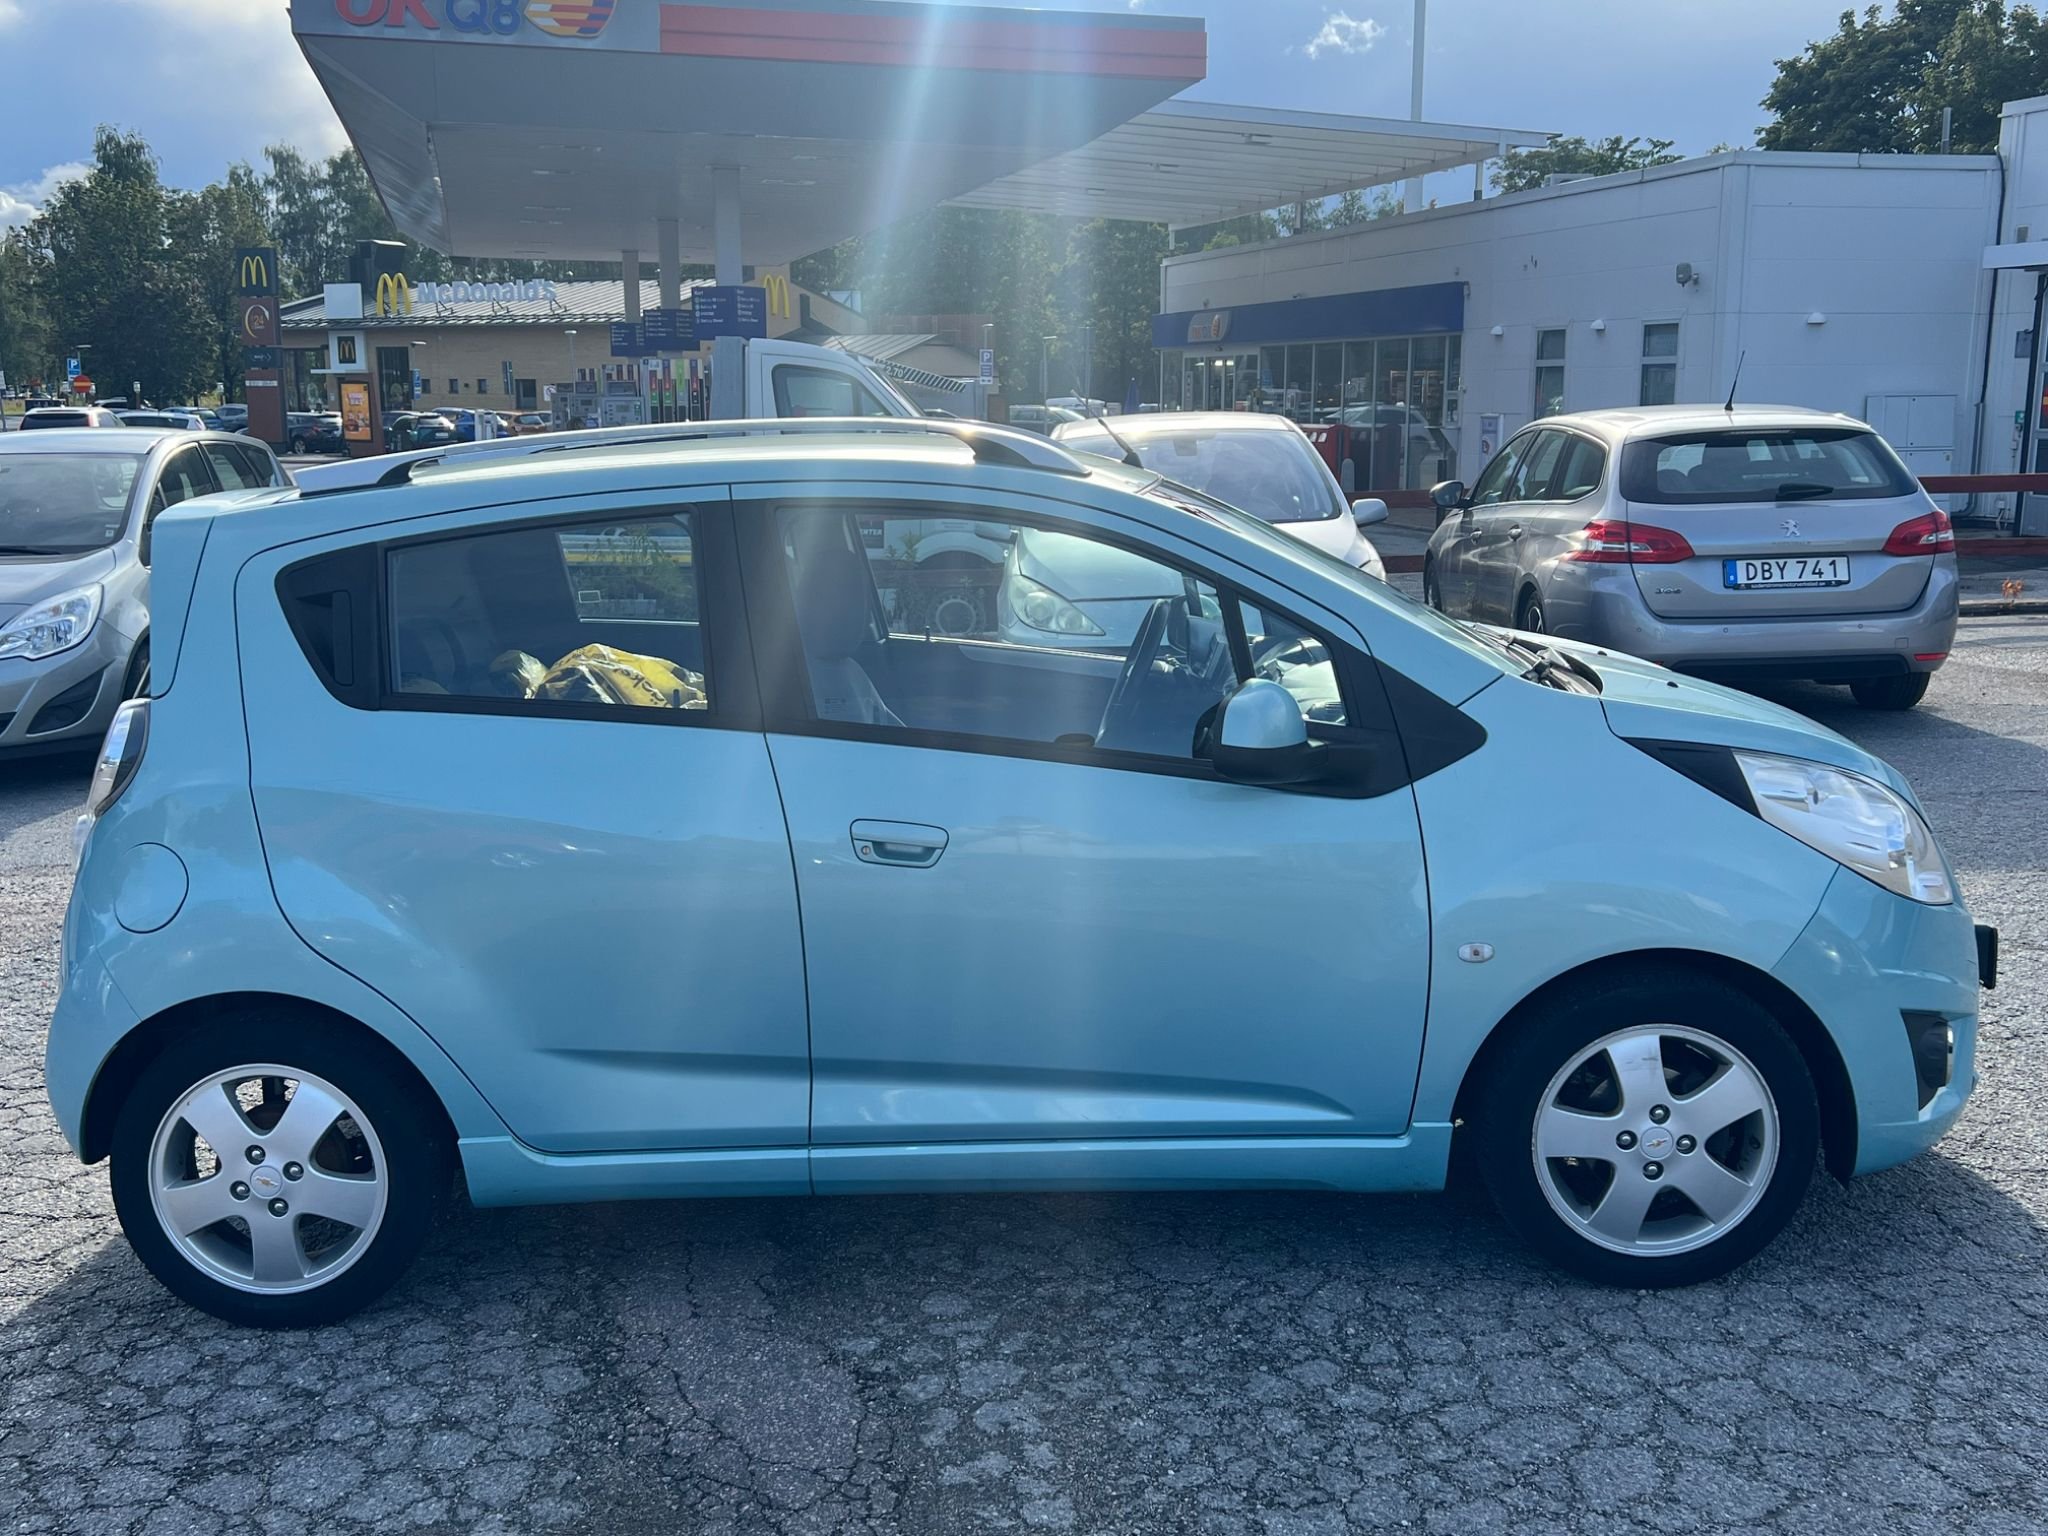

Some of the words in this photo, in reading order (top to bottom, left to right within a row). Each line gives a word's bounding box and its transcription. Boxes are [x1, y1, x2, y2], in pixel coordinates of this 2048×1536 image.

[417, 278, 557, 303] McDonald's
[70, 359, 78, 369] P
[1745, 561, 1788, 581] DBY
[1796, 559, 1838, 579] 741
